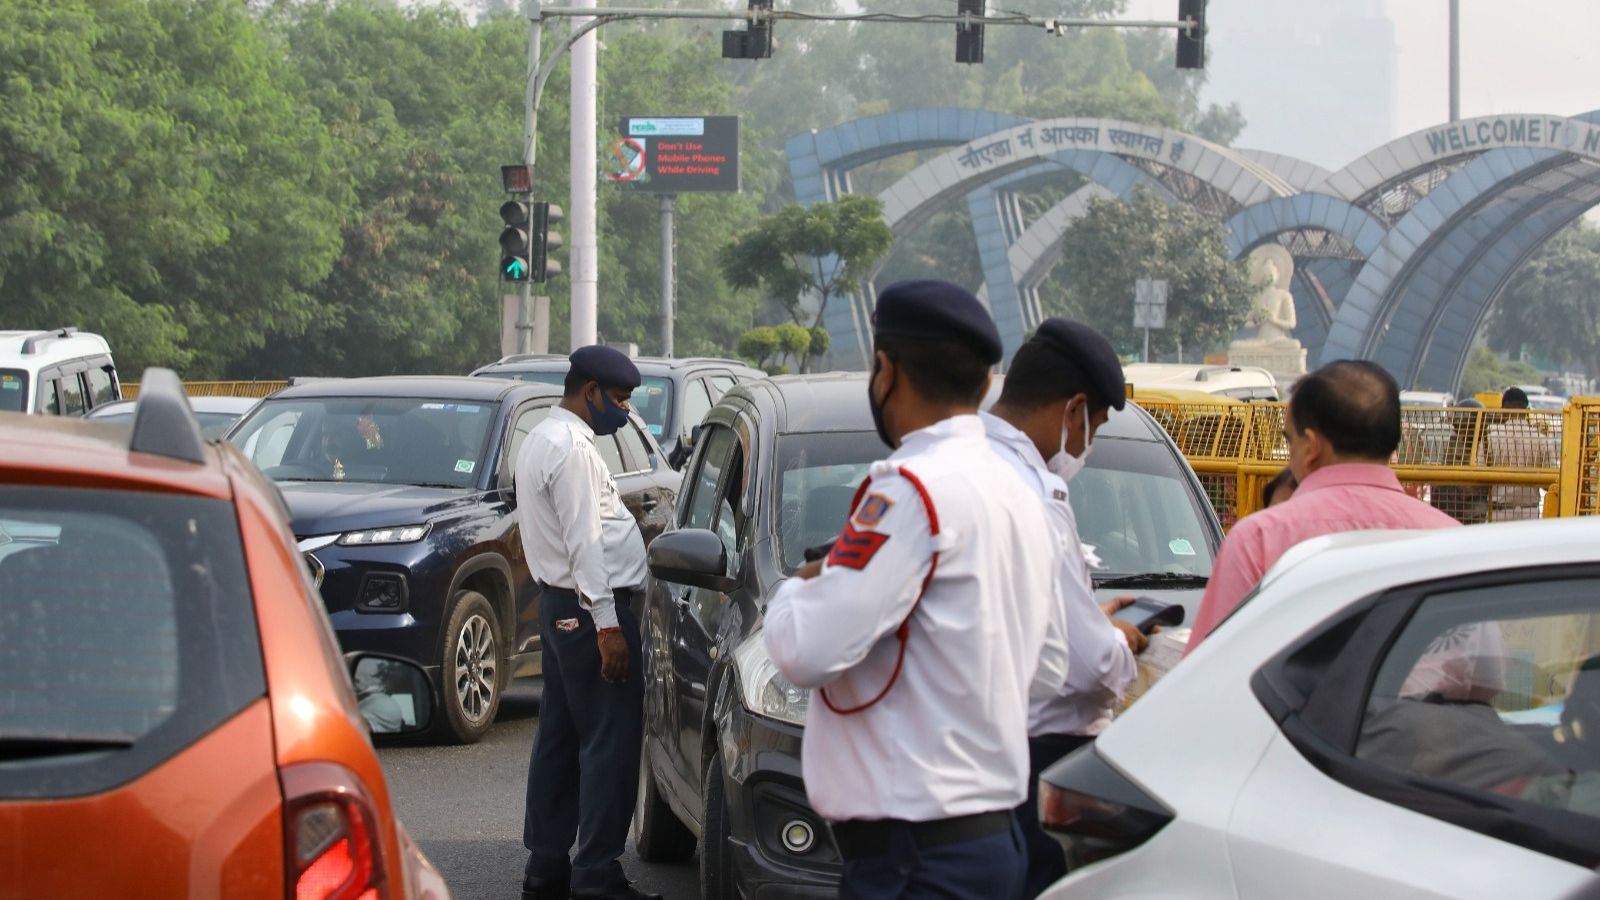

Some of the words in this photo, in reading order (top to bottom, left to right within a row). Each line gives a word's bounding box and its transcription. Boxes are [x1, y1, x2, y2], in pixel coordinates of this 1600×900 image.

[1426, 119, 1540, 154] WELCOME
[657, 142, 683, 151] Don't
[685, 142, 703, 151] Use
[1017, 127, 1035, 149] में
[1040, 126, 1099, 145] आपका
[1108, 128, 1164, 157] स्वागत
[1169, 138, 1185, 164] है
[657, 154, 689, 163] Mobile
[692, 154, 726, 163] Phones
[658, 166, 685, 175] While
[687, 166, 719, 176] Driving
